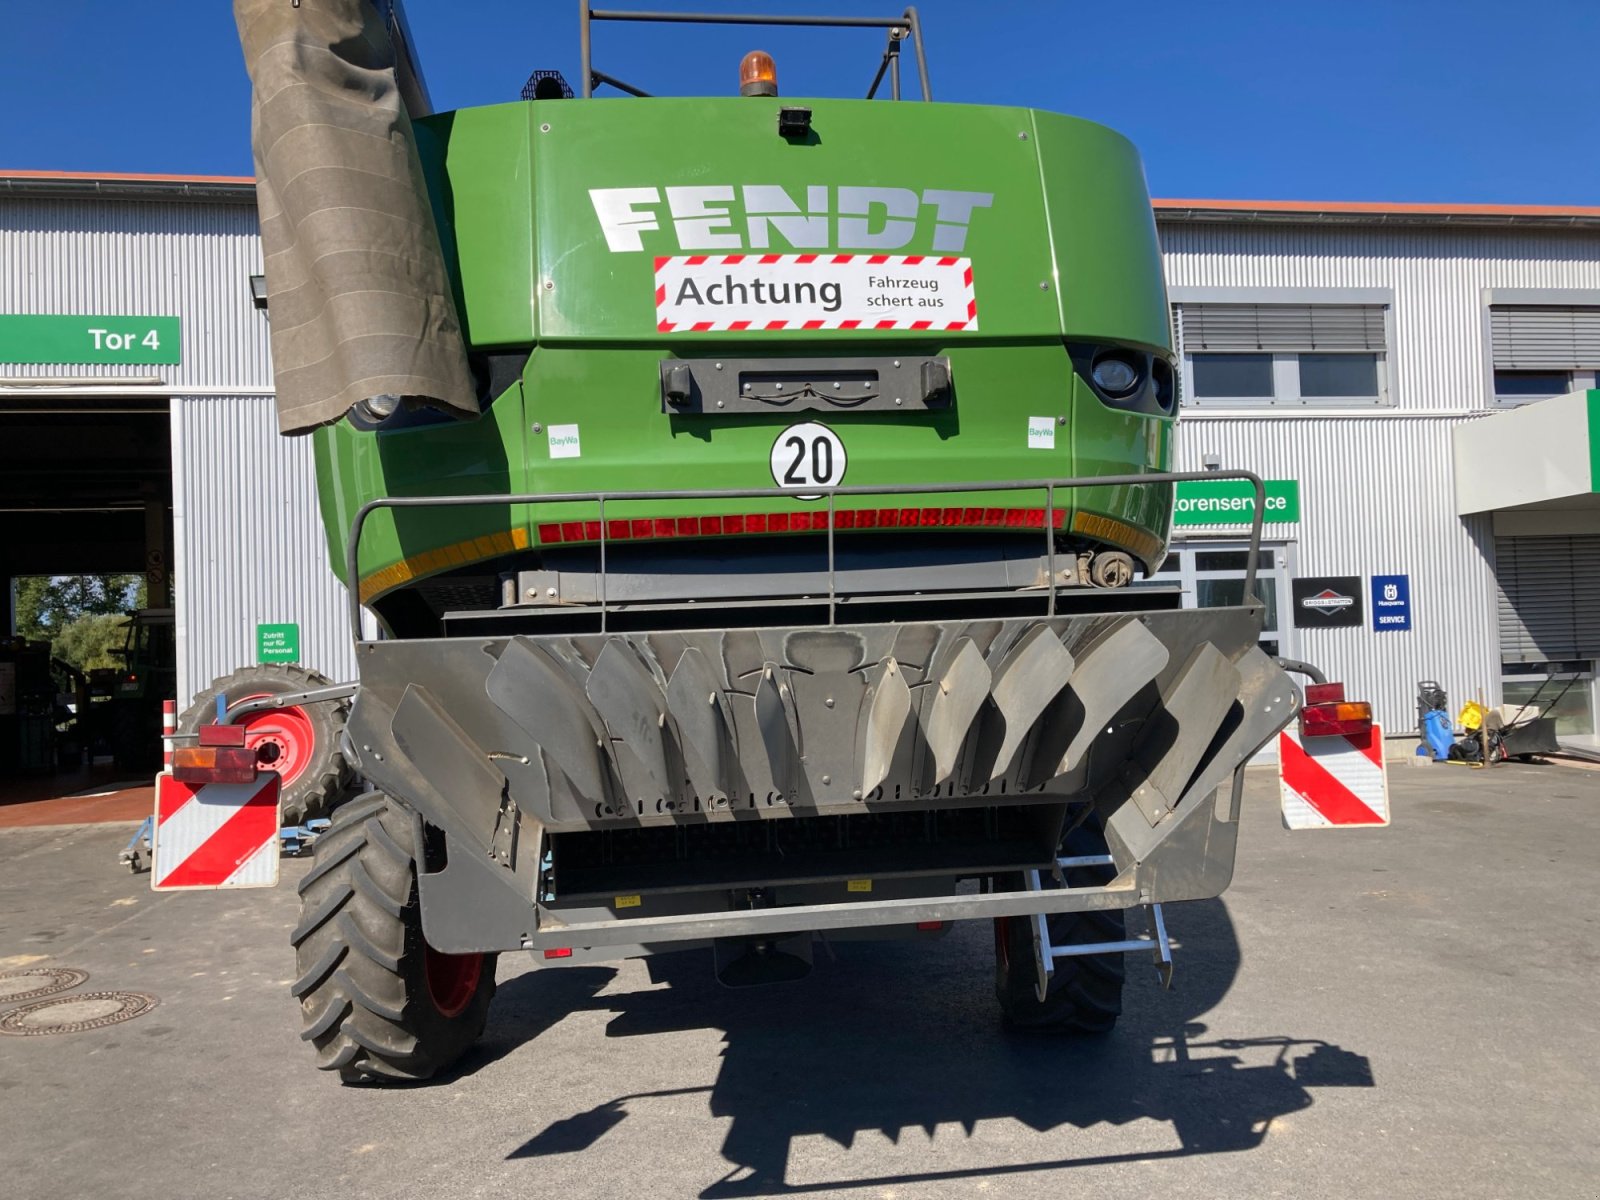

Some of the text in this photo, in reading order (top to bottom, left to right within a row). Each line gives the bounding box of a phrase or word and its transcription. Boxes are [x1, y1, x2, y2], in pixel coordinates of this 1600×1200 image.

[588, 184, 995, 252] FENDT
[868, 276, 939, 292] Fahrzeug
[674, 275, 843, 312] Achtung
[867, 294, 944, 308] schert aus
[88, 329, 160, 350] Tor 4
[550, 436, 578, 446] BayWa
[784, 435, 832, 484] 20
[1379, 615, 1405, 624] SERVICE
